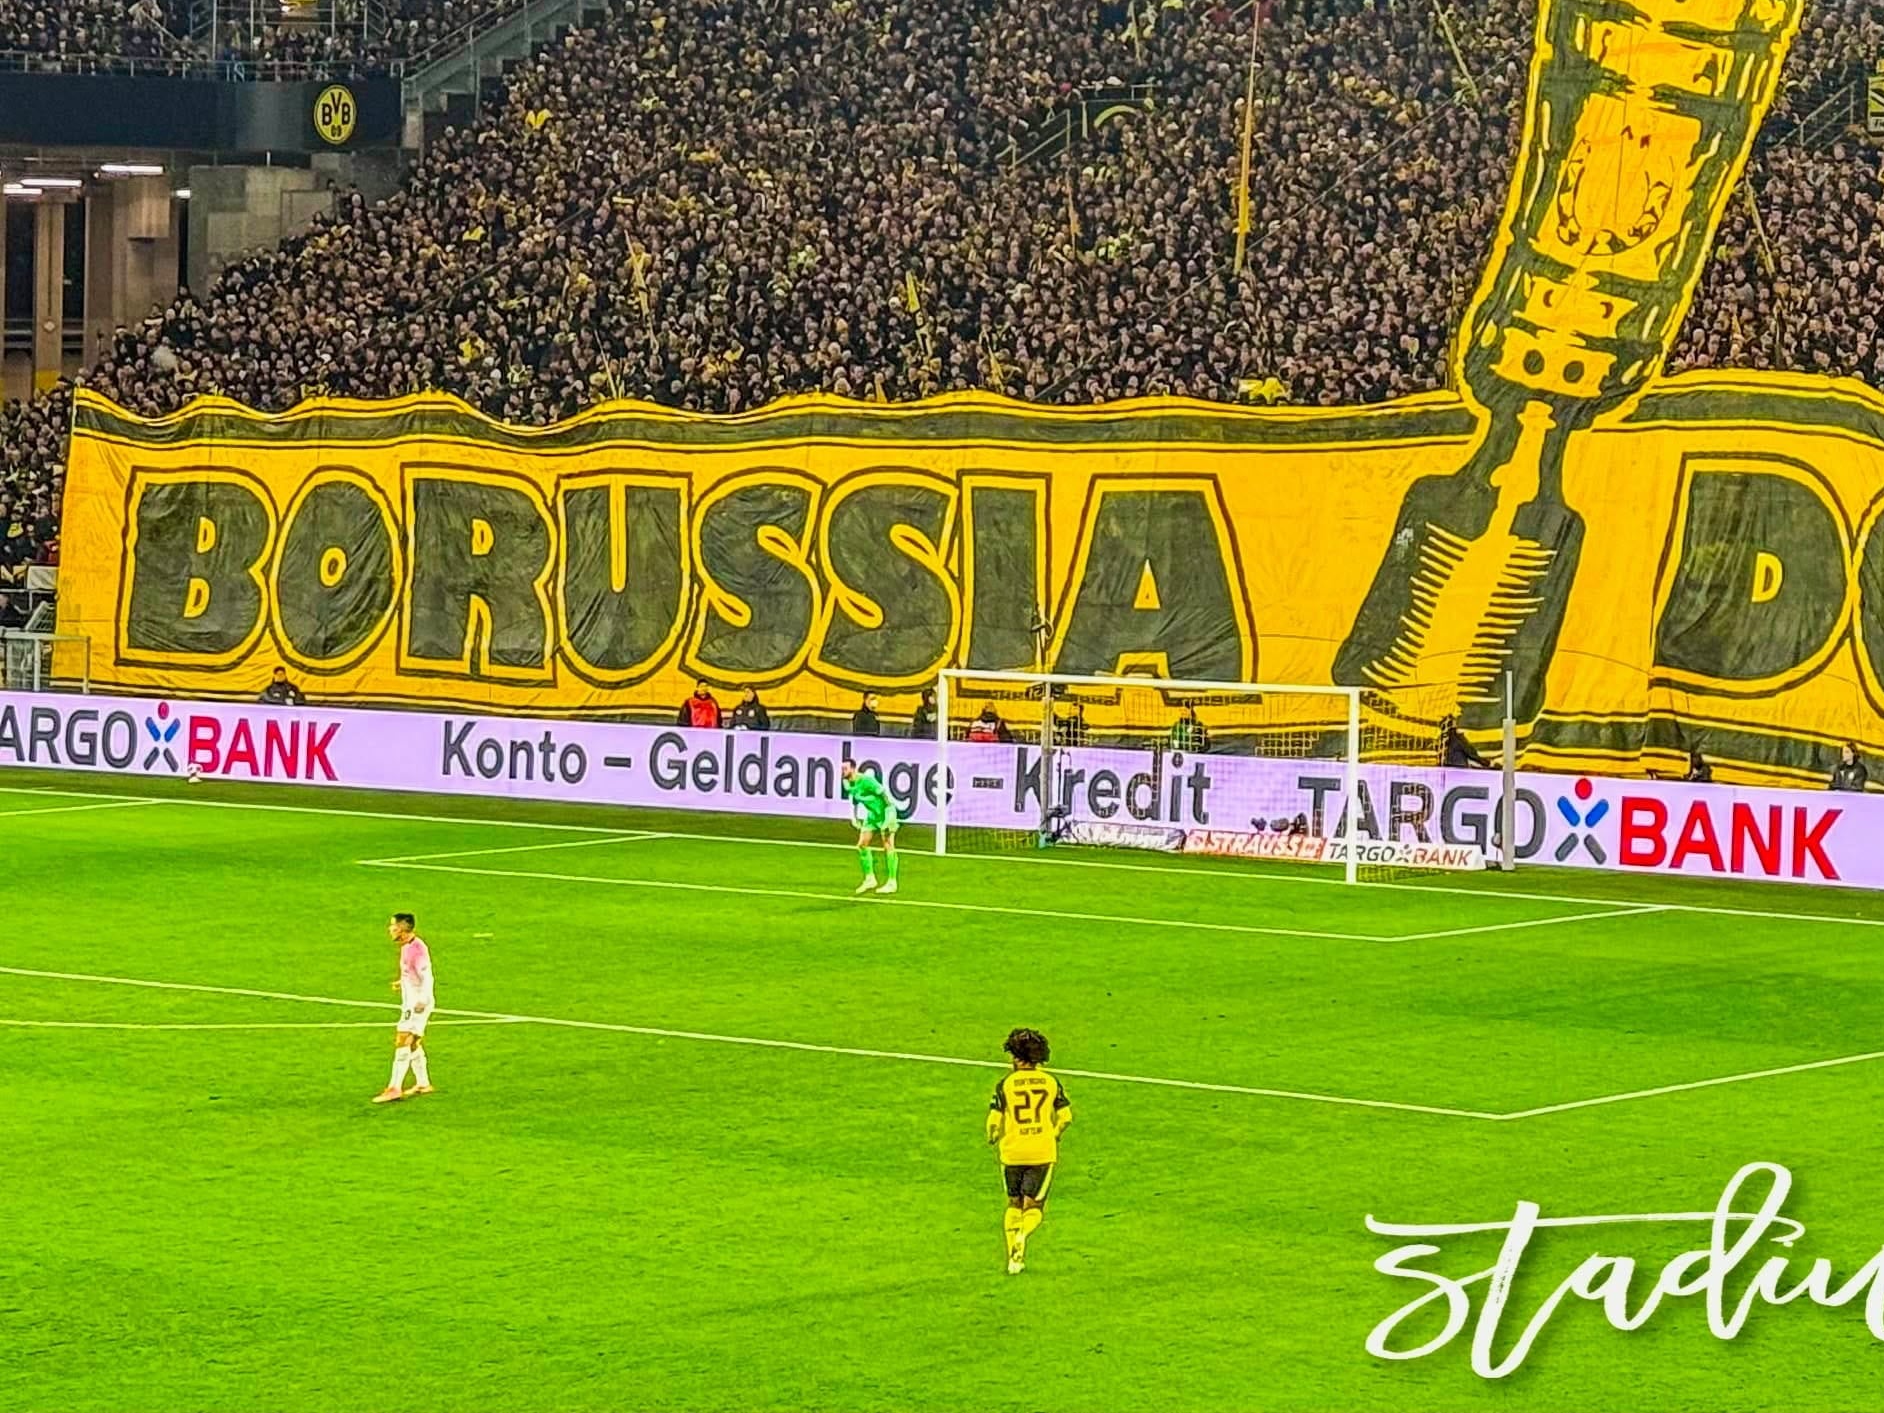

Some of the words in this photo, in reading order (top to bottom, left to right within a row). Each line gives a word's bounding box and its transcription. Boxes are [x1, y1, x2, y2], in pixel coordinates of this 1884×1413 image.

[321, 91, 351, 126] BVB
[118, 464, 1258, 702] BORUSSIA
[187, 714, 341, 782] BANK
[442, 720, 588, 785] Konto
[1014, 745, 1211, 825] Kredit
[1297, 776, 1547, 860] TARGO
[1620, 796, 1843, 882] BANK
[1412, 845, 1474, 867] BANK
[1013, 1089, 1049, 1124] 27
